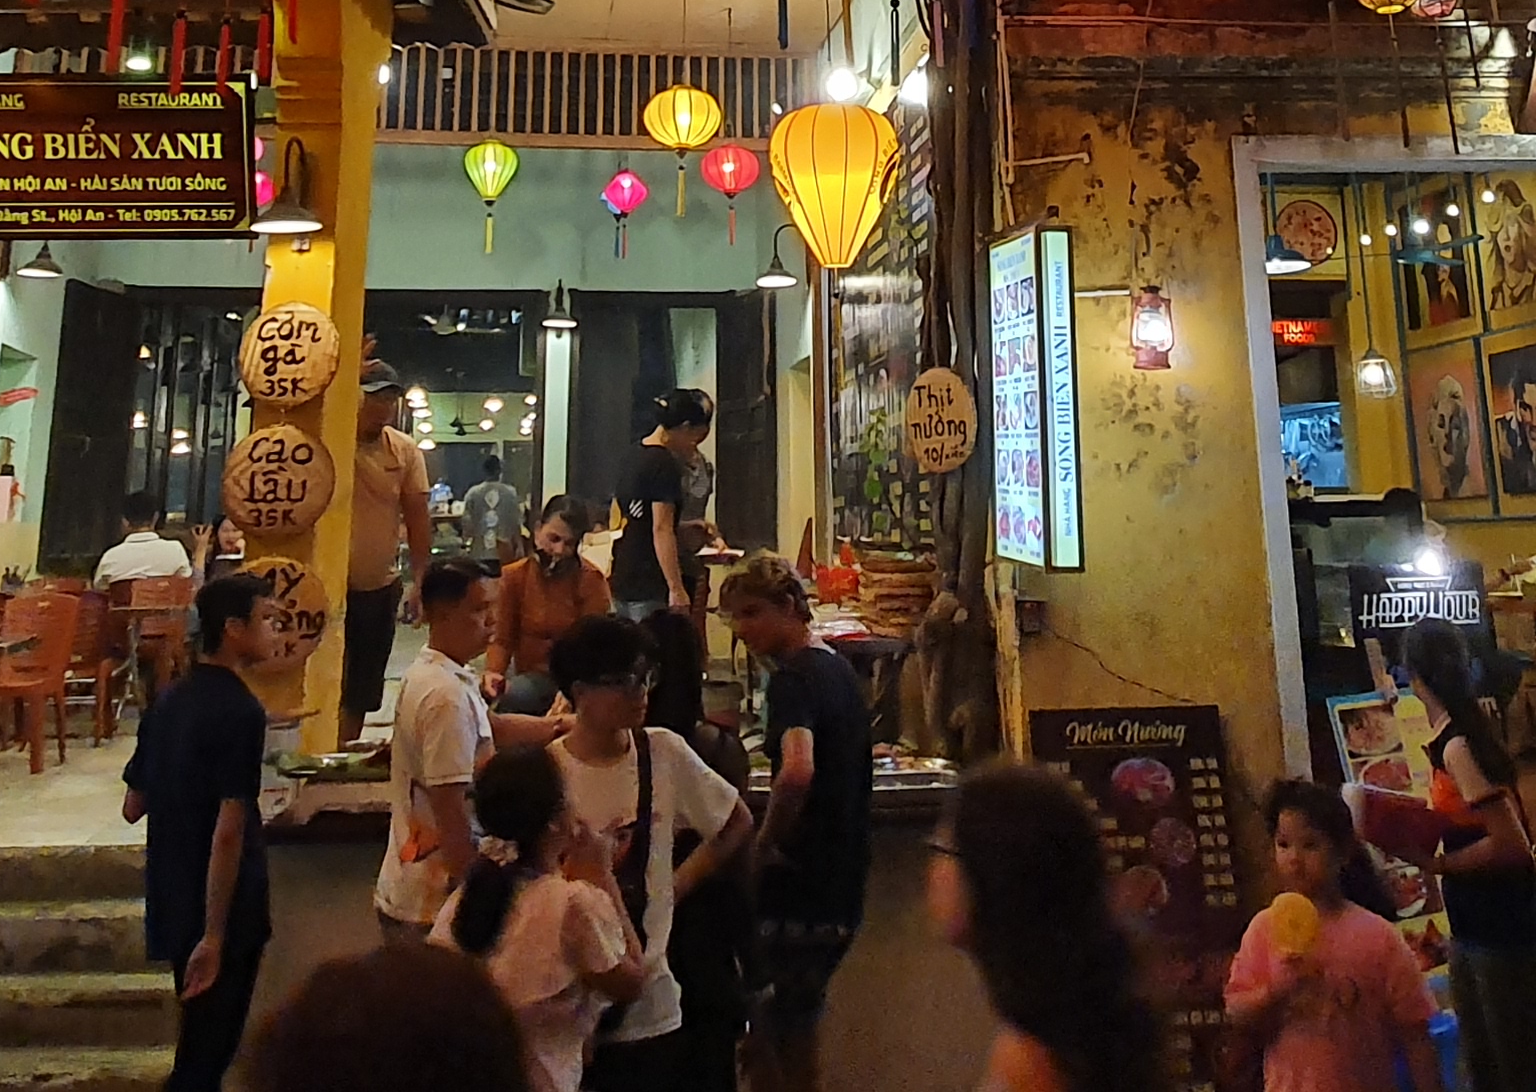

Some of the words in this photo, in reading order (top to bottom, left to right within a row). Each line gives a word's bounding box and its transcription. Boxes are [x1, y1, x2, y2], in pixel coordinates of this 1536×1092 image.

[43, 117, 121, 160] BIỂN
[131, 132, 223, 160] XANH
[13, 174, 41, 193] HỘI
[44, 177, 68, 191] AN
[58, 208, 82, 223] Hội
[84, 209, 105, 222] An
[116, 209, 142, 222] Tel:
[143, 209, 236, 222] 0905.762.567
[1053, 324, 1070, 376] XANH
